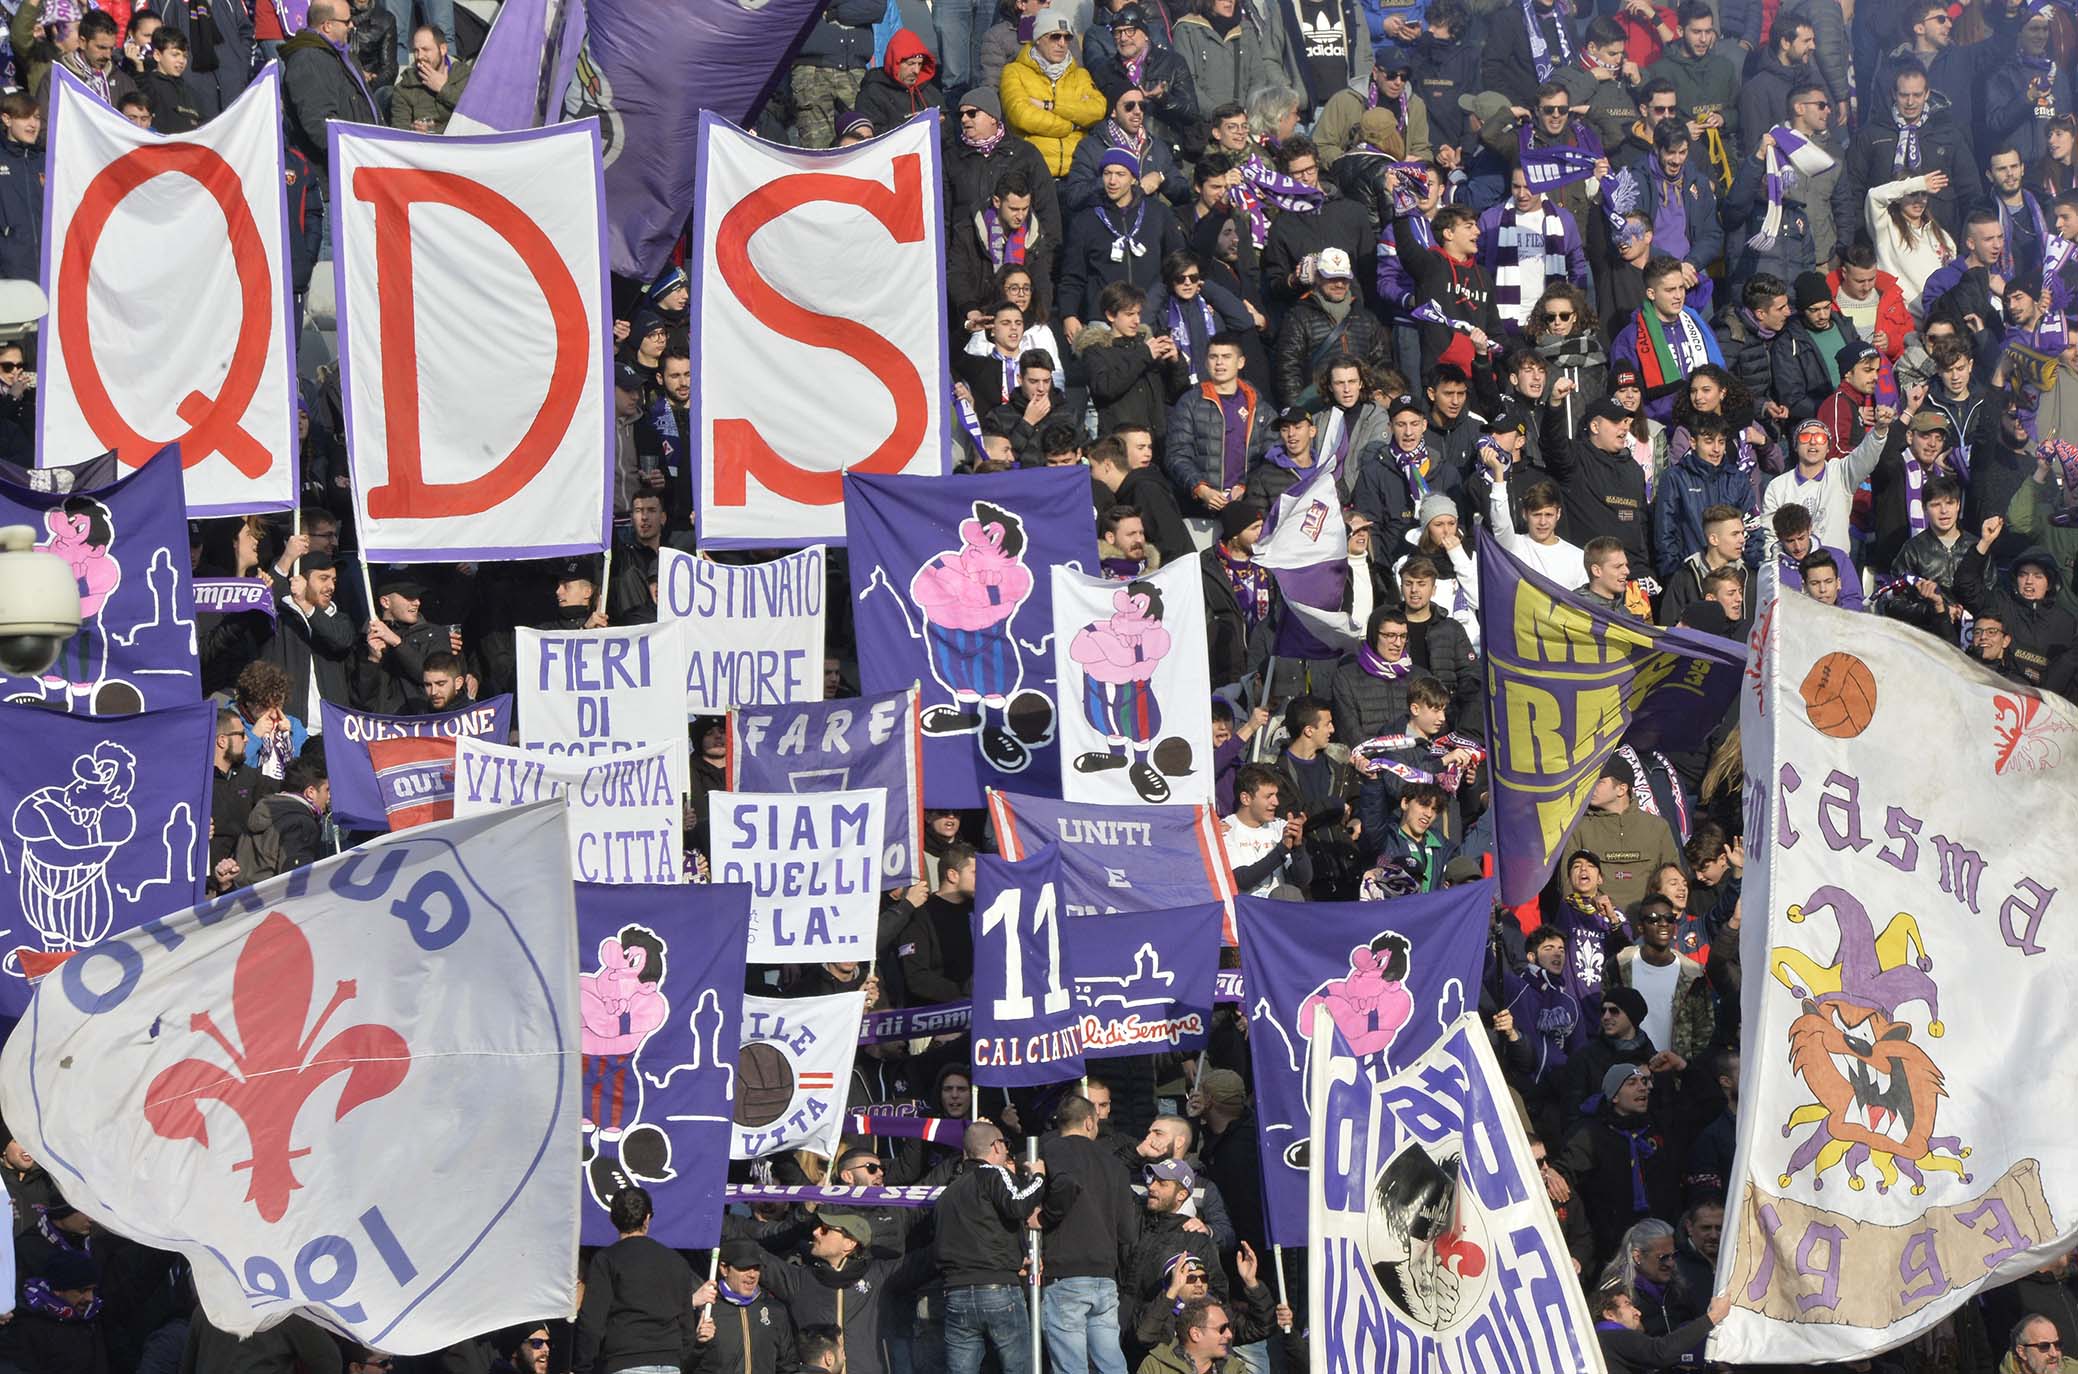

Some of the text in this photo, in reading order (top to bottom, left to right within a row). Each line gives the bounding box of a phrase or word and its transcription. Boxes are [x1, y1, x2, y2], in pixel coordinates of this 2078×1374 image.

[1306, 45, 1345, 57] adidas
[57, 142, 273, 480] Q
[715, 153, 926, 505] S
[353, 167, 589, 519] D
[668, 550, 821, 618] OSTINATO
[539, 635, 651, 691] FIERI
[687, 649, 806, 707] AMORE
[577, 696, 611, 738] DI
[745, 700, 897, 756] FARE
[581, 755, 674, 807] CURVA
[731, 803, 869, 850] SIAM
[1058, 818, 1152, 846] UNITI
[982, 882, 1071, 1020] 11
[750, 1012, 817, 1057] ILE
[1127, 1014, 1201, 1043] Sempre
[741, 1096, 828, 1155] VITA
[1747, 1198, 2032, 1313] 1993
